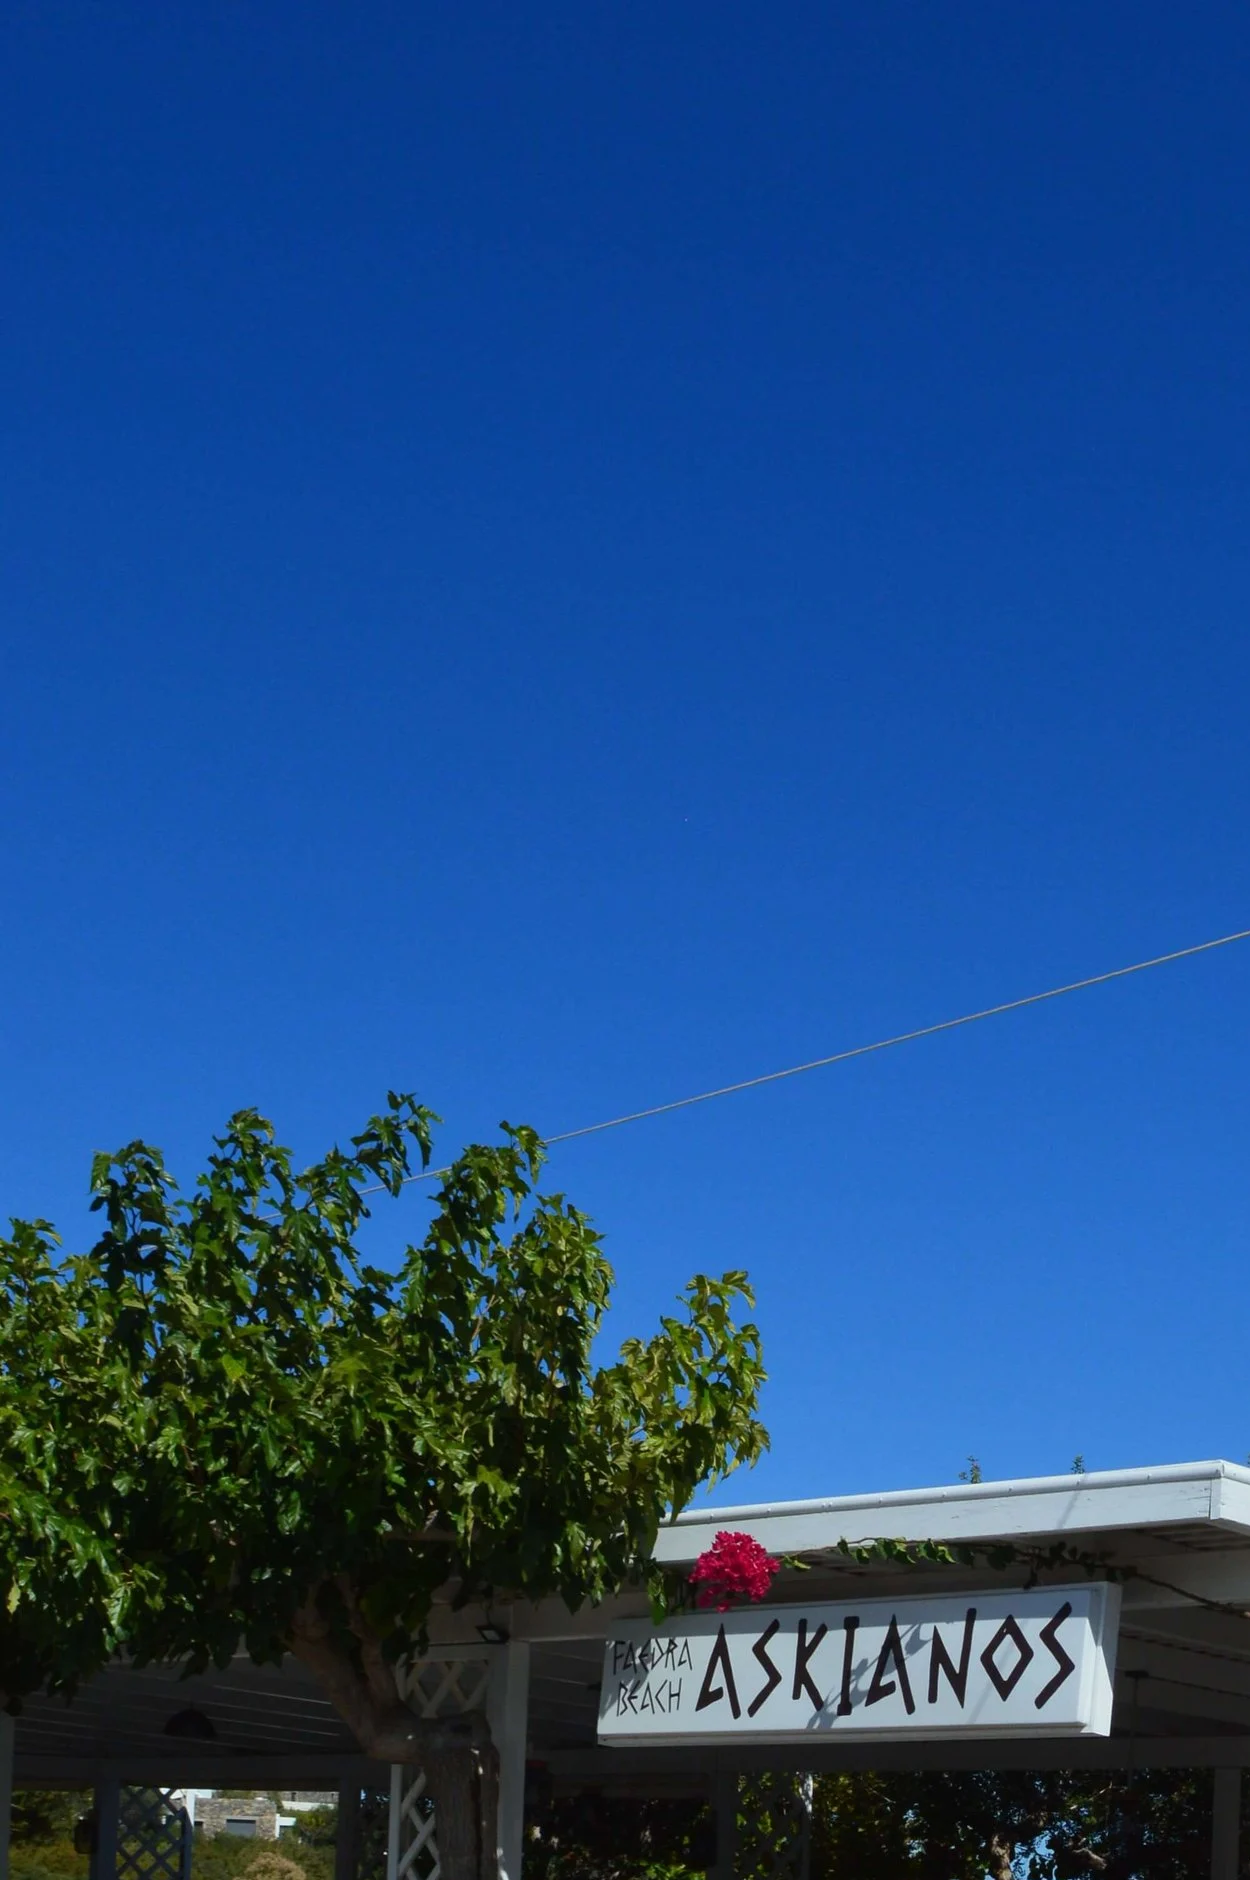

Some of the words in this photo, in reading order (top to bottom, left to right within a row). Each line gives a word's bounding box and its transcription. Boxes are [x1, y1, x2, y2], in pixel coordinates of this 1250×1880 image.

[613, 1637, 693, 1676] FAEDRA
[695, 1601, 1076, 1719] ASKIANOS
[616, 1677, 682, 1716] BEACH
